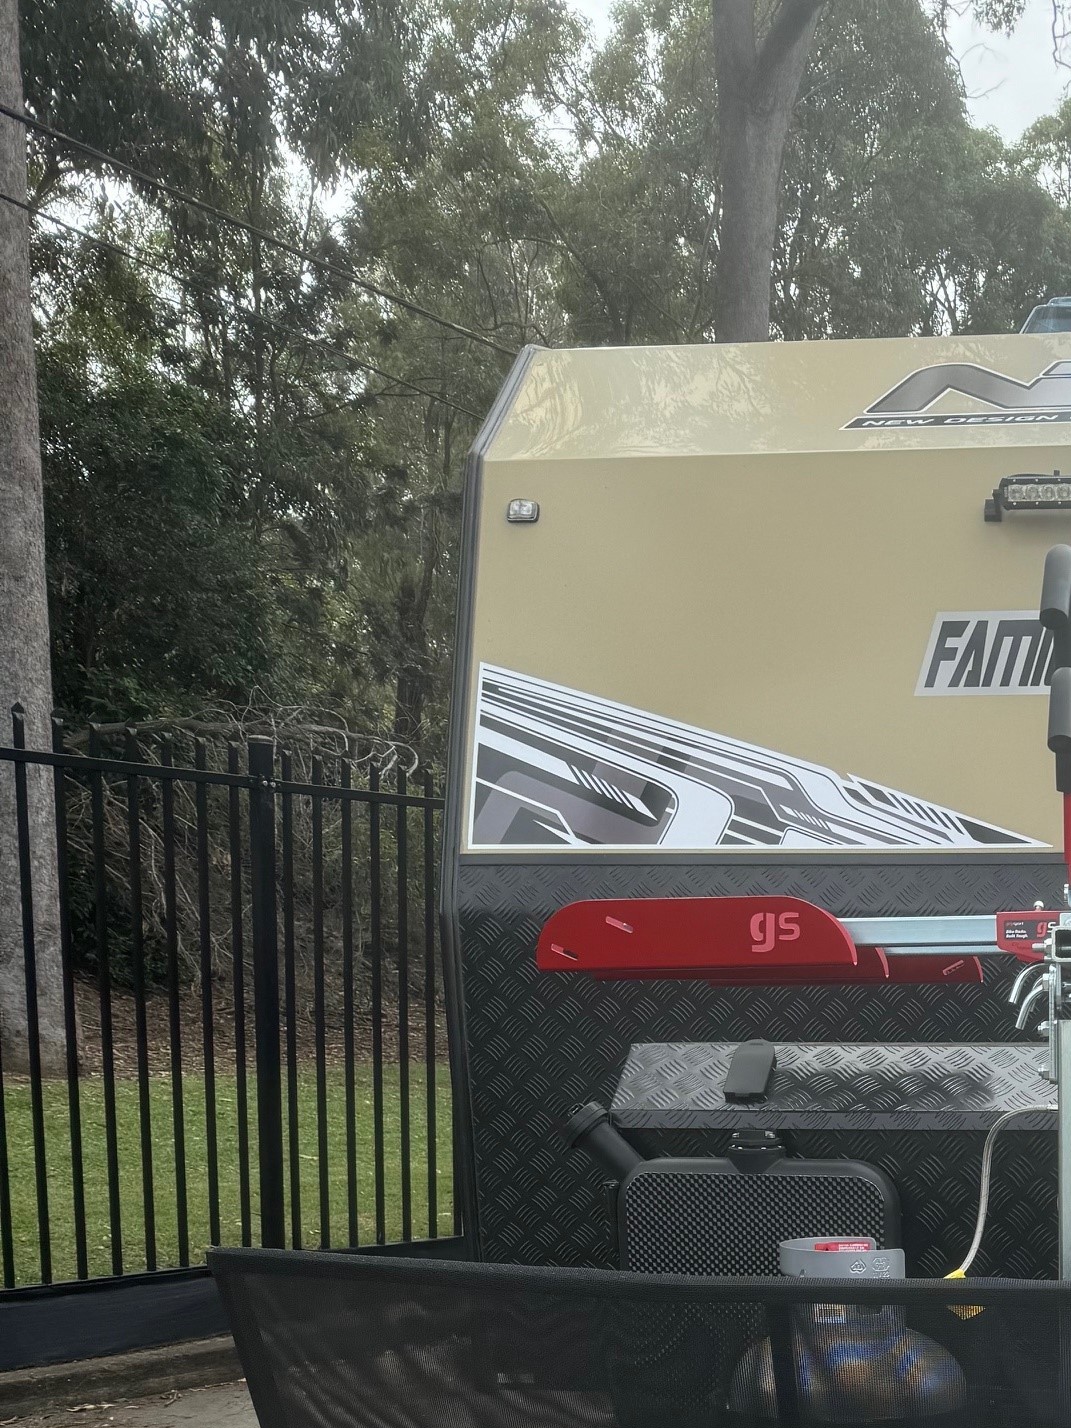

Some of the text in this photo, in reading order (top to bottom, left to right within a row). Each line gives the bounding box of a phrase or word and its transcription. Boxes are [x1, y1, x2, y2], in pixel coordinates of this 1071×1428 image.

[862, 418, 934, 427] NEW
[943, 415, 1059, 424] DESIGN
[924, 619, 1066, 688] FAMI
[750, 911, 801, 953] gs
